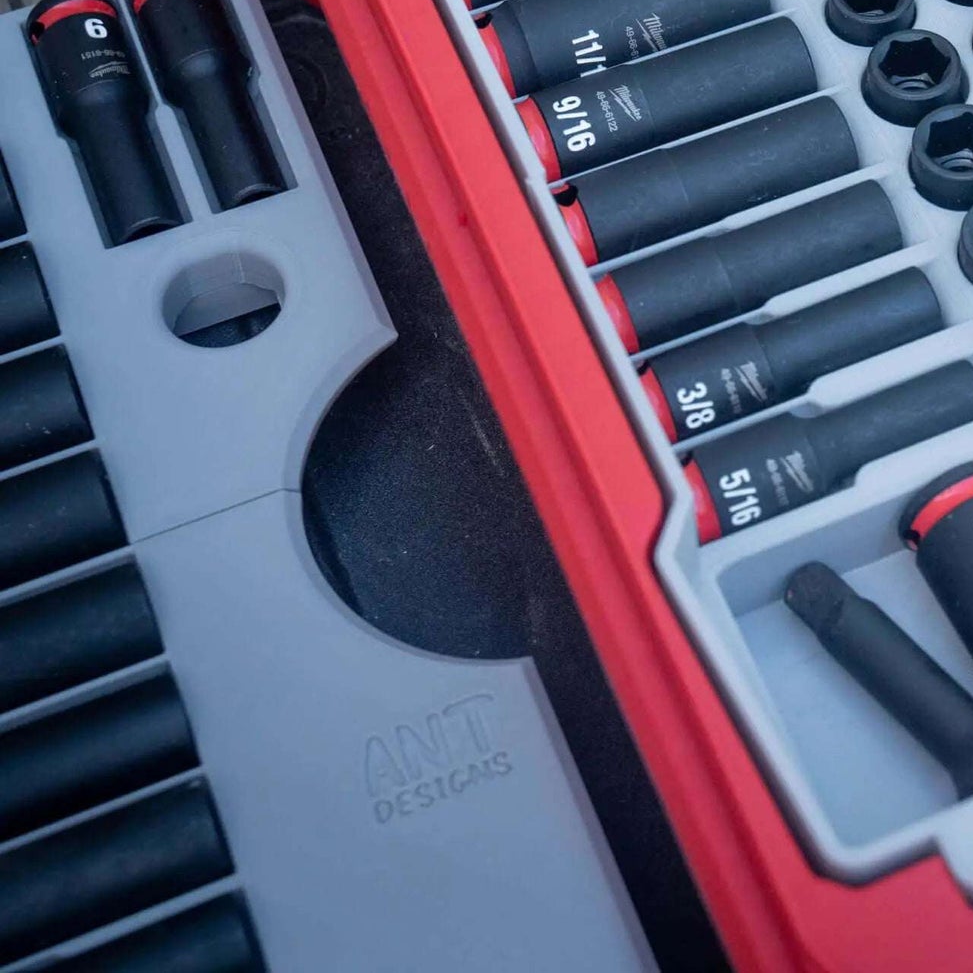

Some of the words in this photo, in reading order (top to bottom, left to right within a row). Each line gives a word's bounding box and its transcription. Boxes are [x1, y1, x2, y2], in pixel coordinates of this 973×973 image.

[572, 29, 608, 77] 11/1
[625, 25, 641, 60] 49-66-61
[553, 95, 596, 153] 9/16
[614, 84, 642, 121] Milwaukee
[676, 382, 716, 429] 3/8
[719, 468, 762, 526] 5/16
[364, 693, 496, 798] ANT
